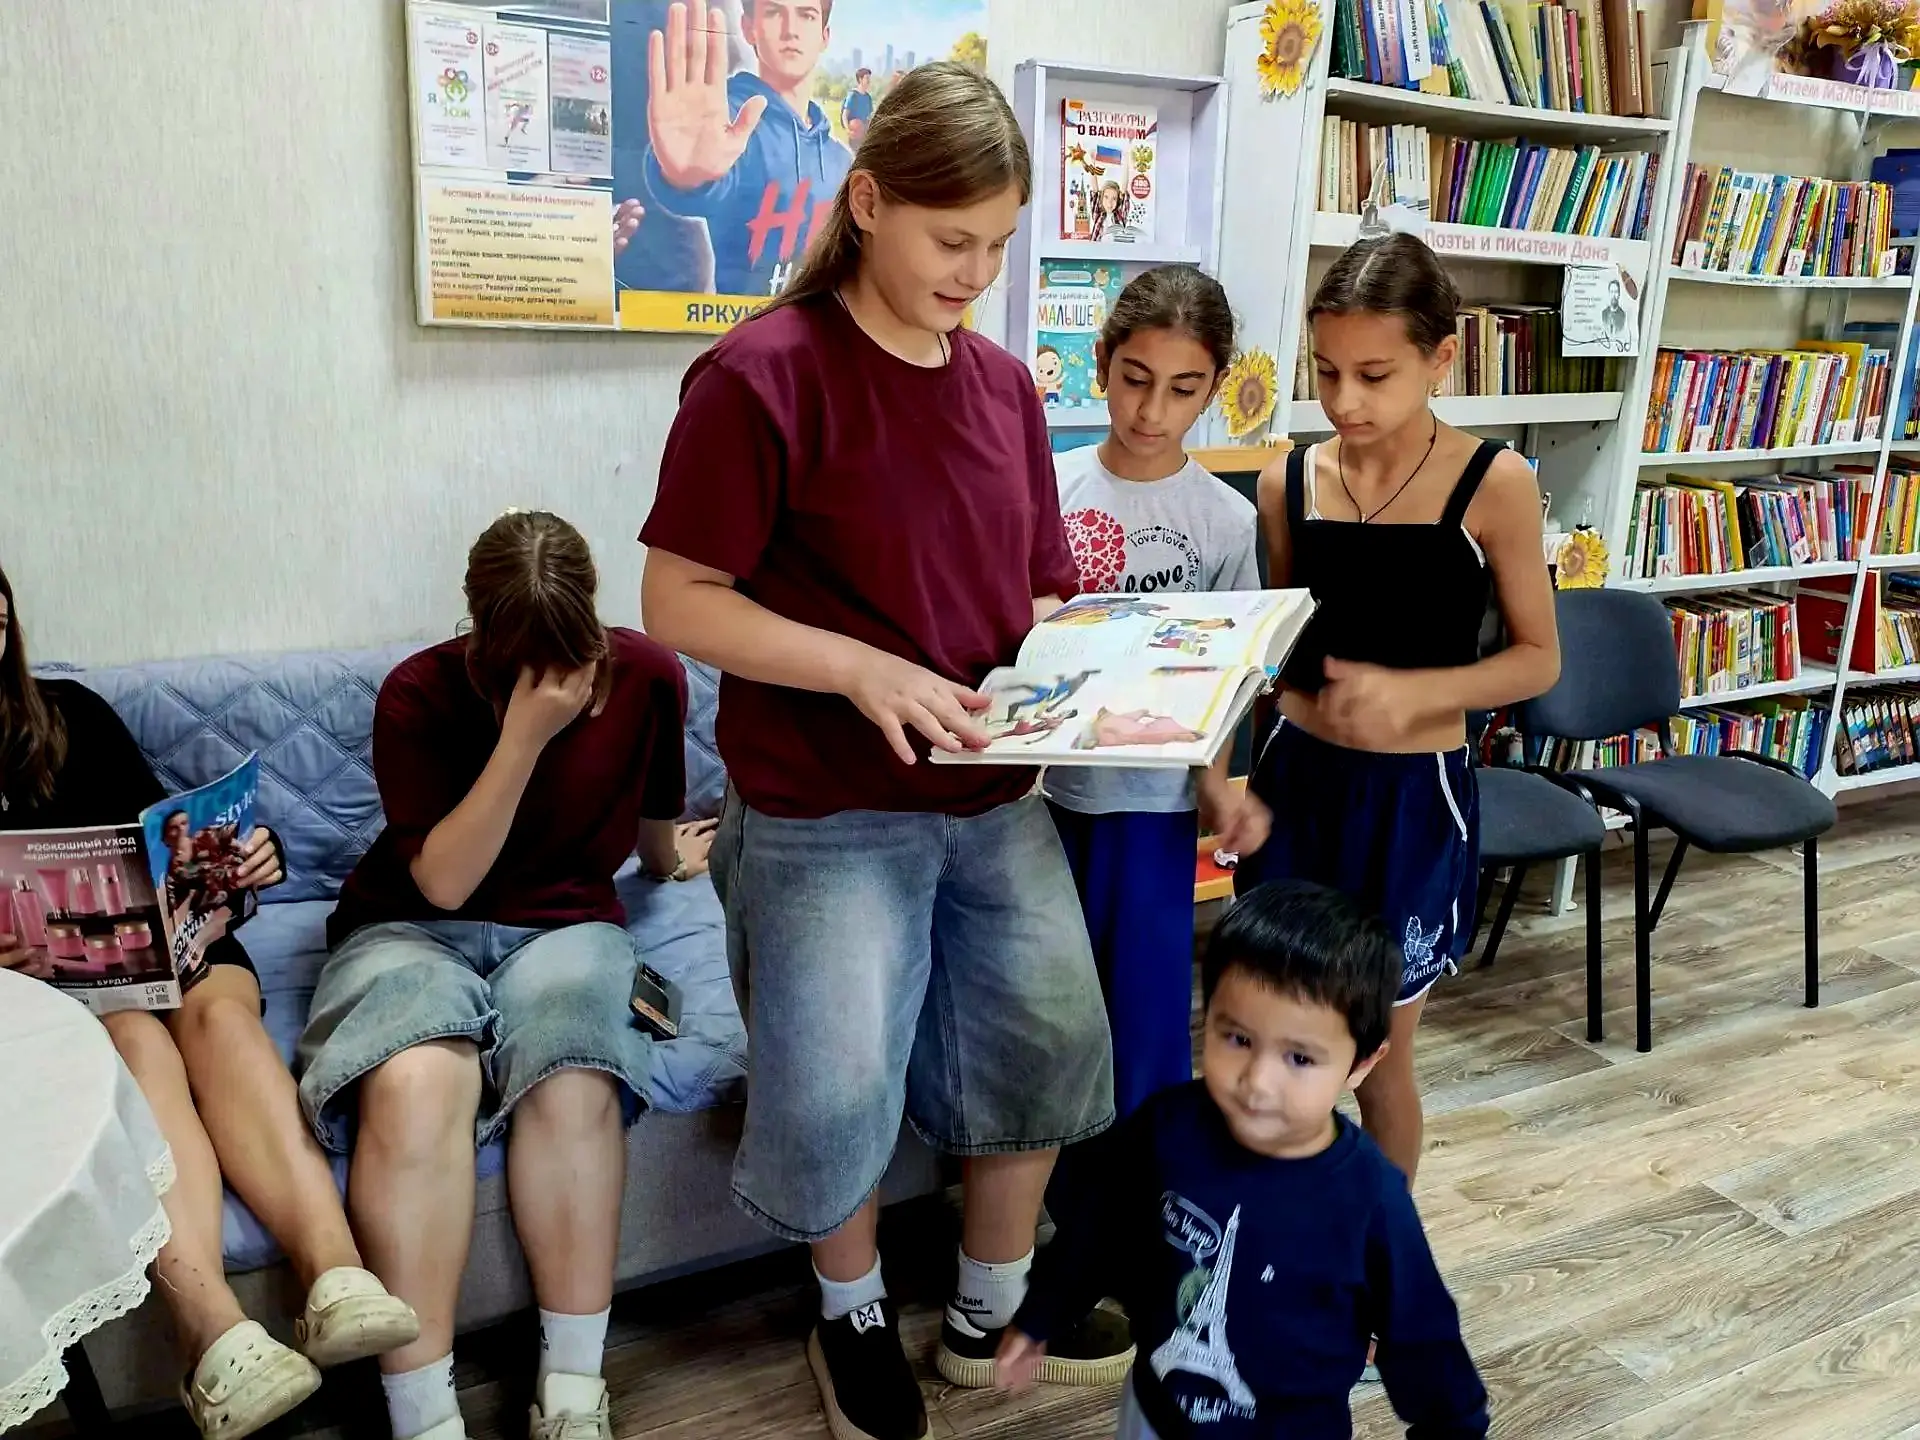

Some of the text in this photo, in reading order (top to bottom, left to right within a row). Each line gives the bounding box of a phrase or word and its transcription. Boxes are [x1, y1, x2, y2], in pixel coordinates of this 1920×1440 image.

[1088, 124, 1147, 140] ВАЖНОМ
[1424, 229, 1610, 262] Поэты и писатели Дона
[1130, 533, 1158, 548] love
[1161, 532, 1186, 551] love
[27, 836, 137, 852] РОСКОШНЫЙ УХОД
